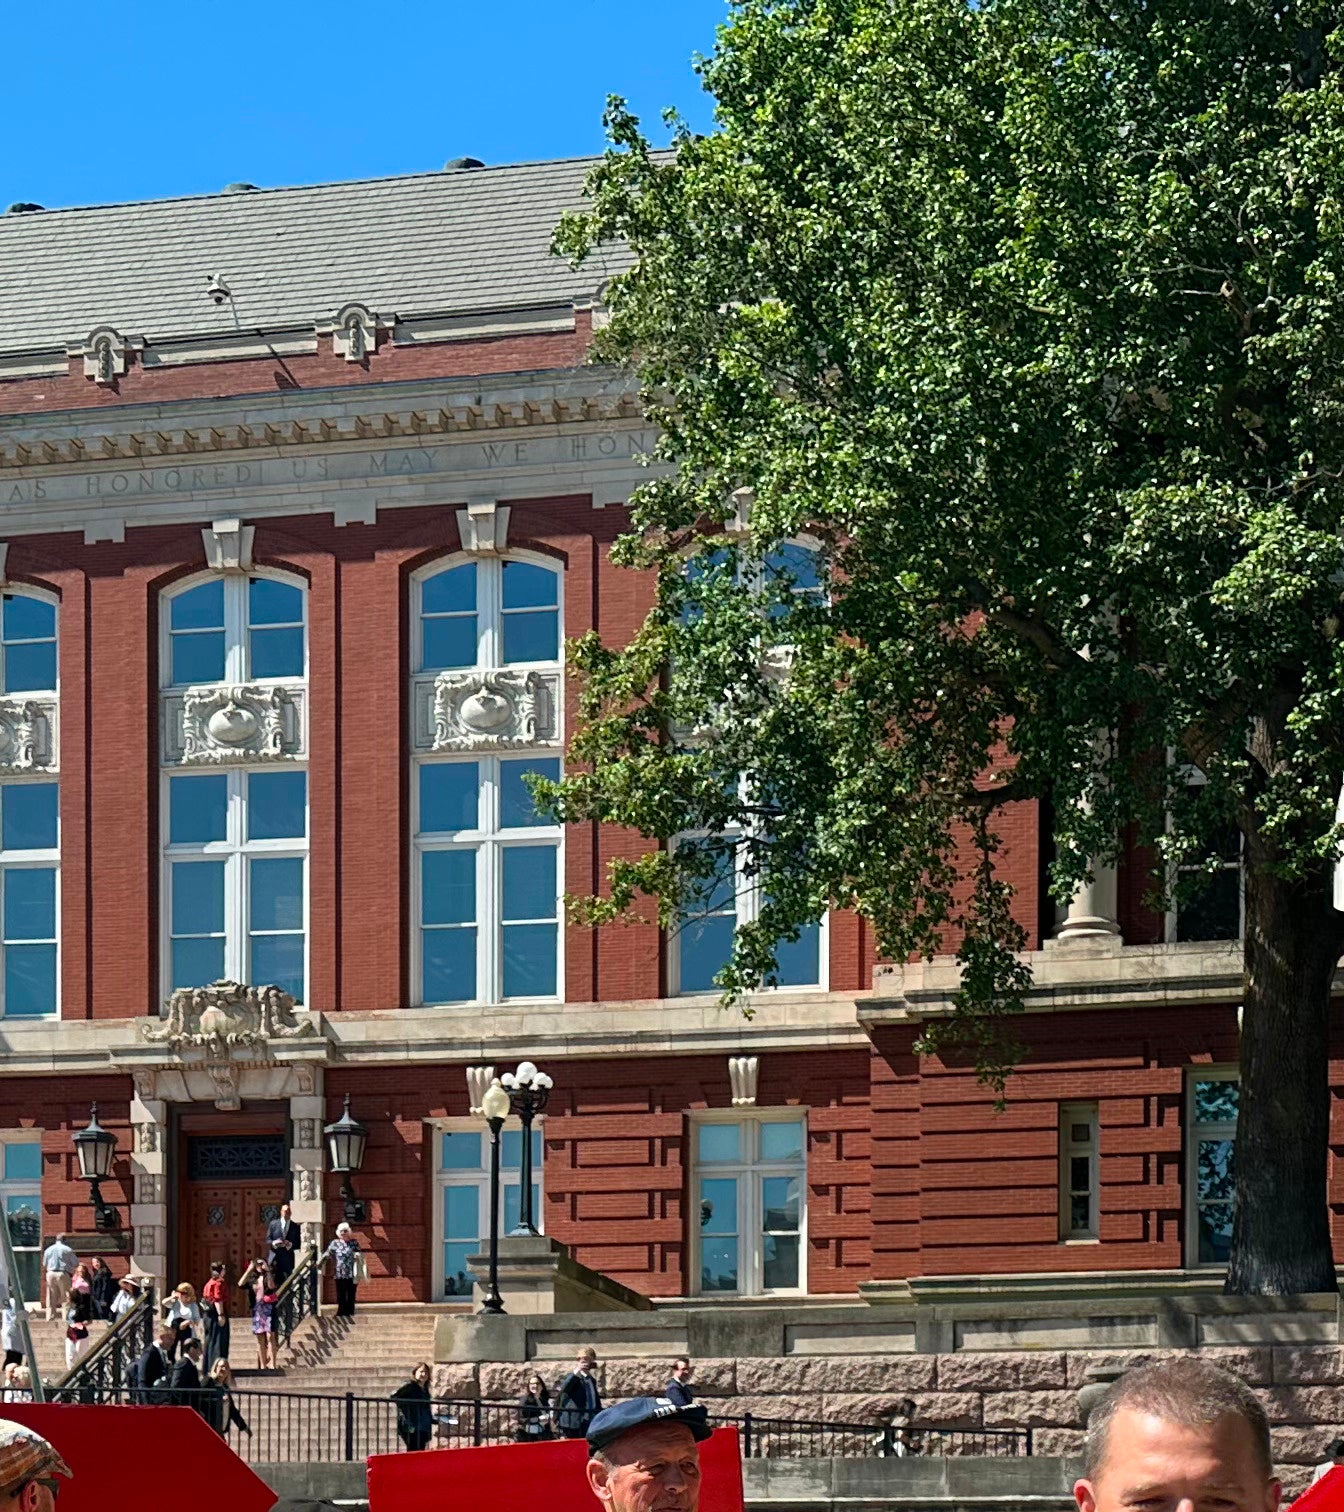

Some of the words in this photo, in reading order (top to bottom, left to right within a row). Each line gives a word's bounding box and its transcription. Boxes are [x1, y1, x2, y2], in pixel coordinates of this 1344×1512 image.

[86, 464, 252, 496] HONORED
[292, 457, 330, 480] US
[370, 450, 439, 474] MAY
[481, 442, 529, 466] WE
[570, 431, 646, 459] HON
